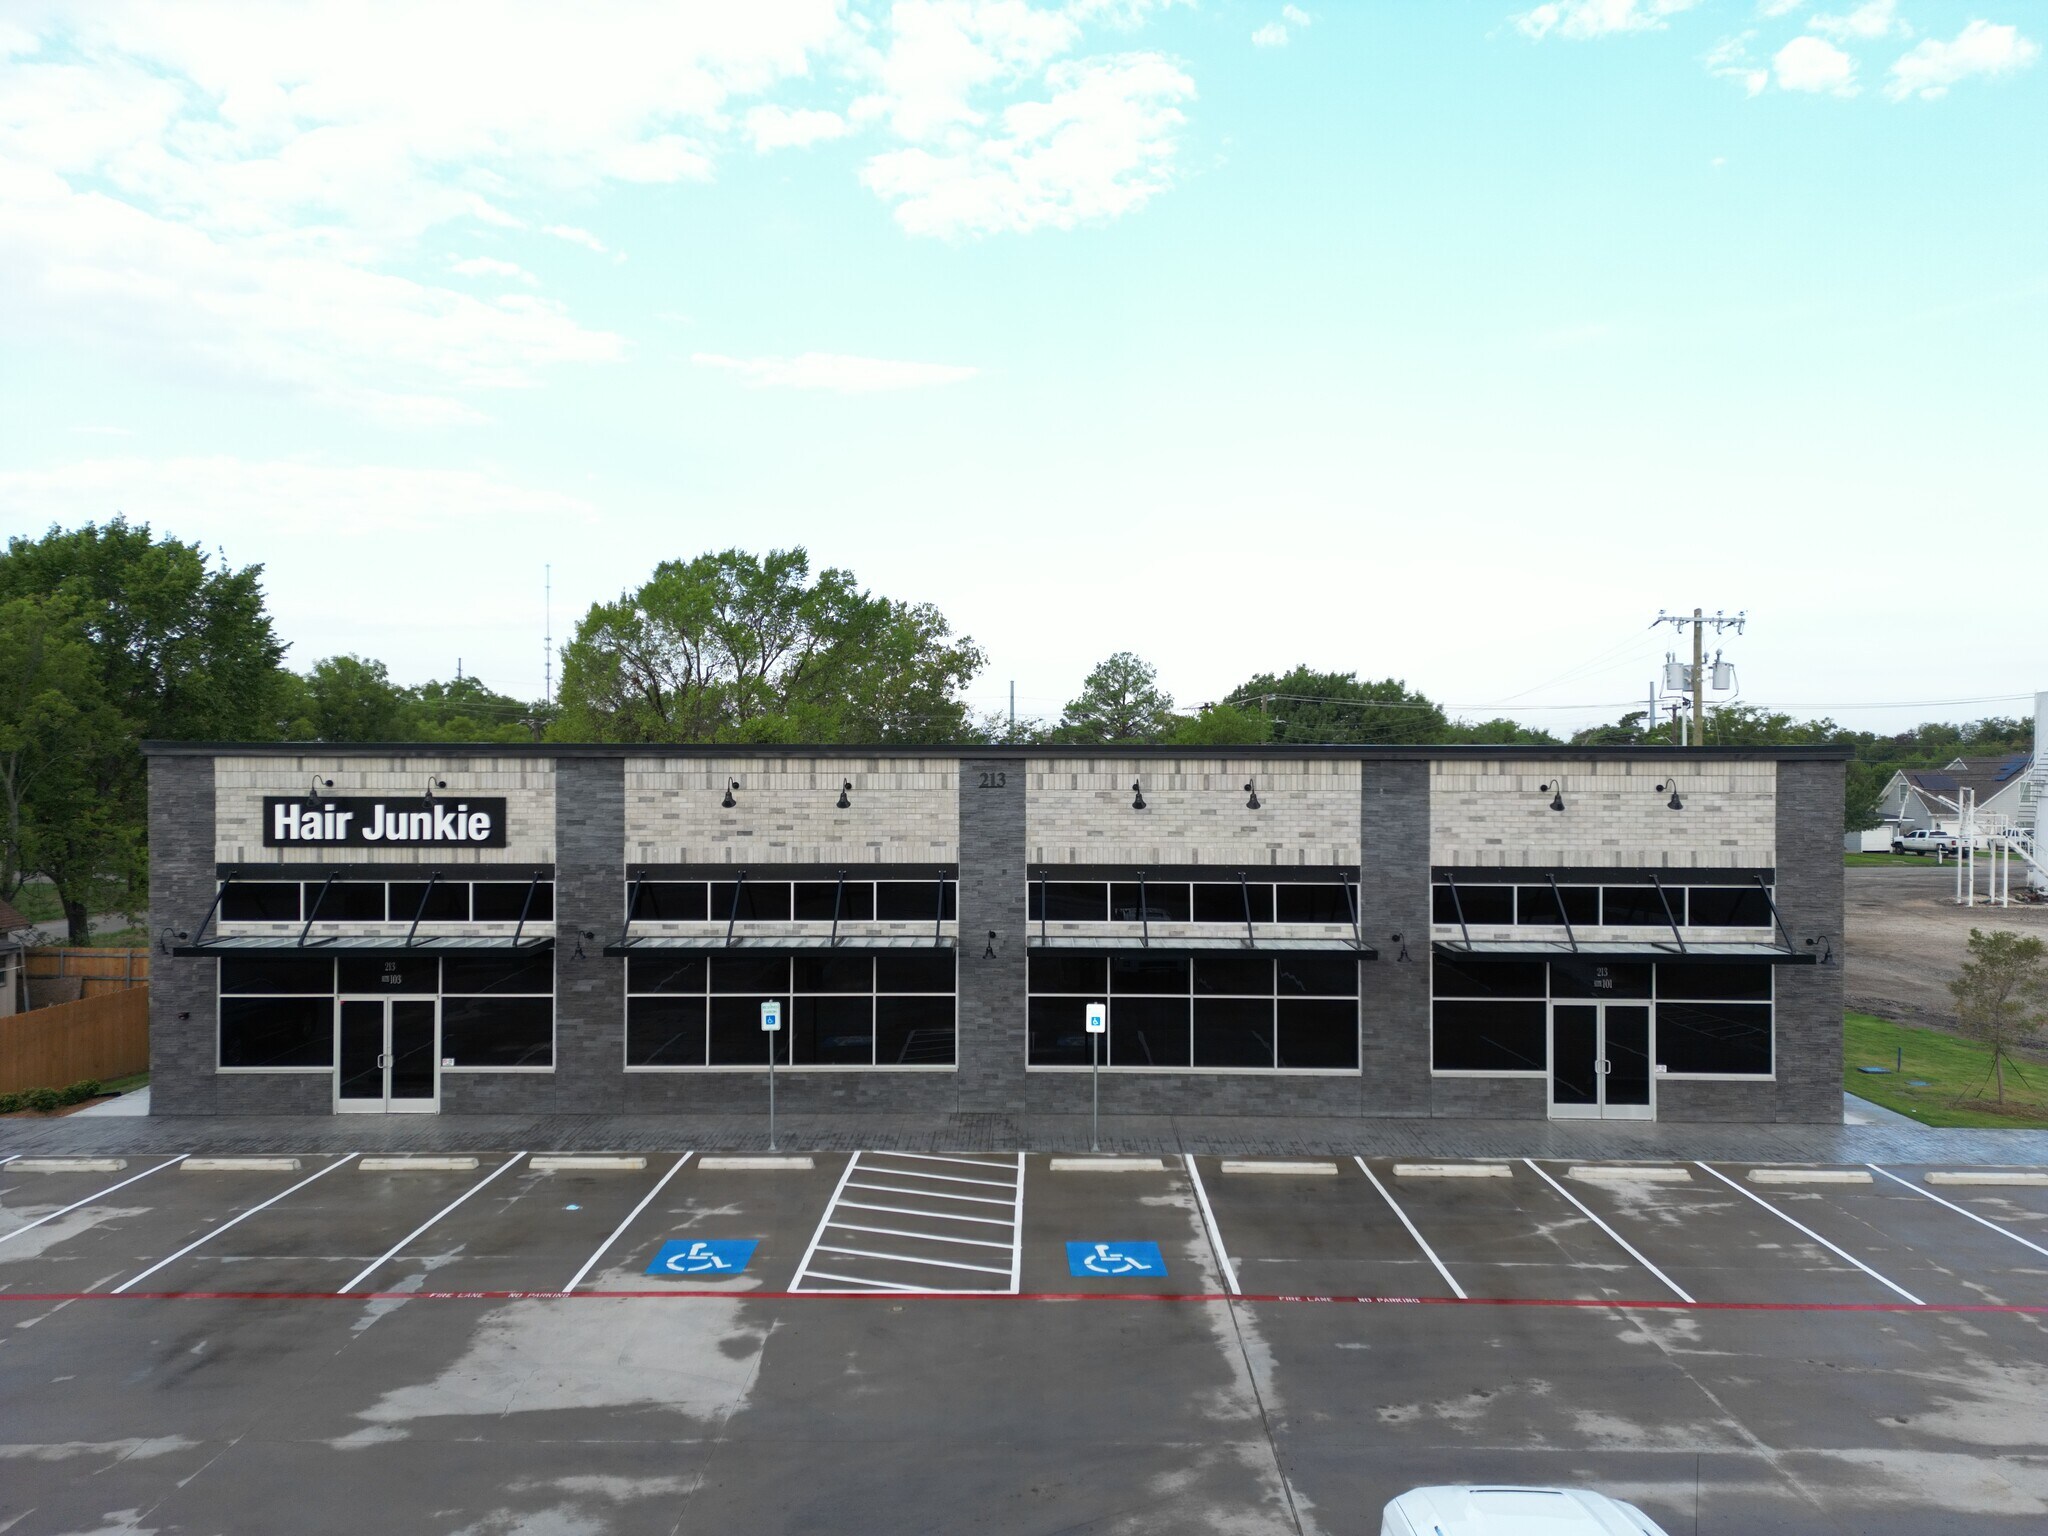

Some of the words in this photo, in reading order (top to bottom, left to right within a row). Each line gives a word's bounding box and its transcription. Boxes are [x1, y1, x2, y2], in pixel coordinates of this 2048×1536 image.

[979, 772, 1006, 788] 213
[274, 804, 354, 840] Hair
[362, 804, 491, 841] Junkie
[384, 961, 396, 971] 213
[1596, 967, 1609, 977] 213
